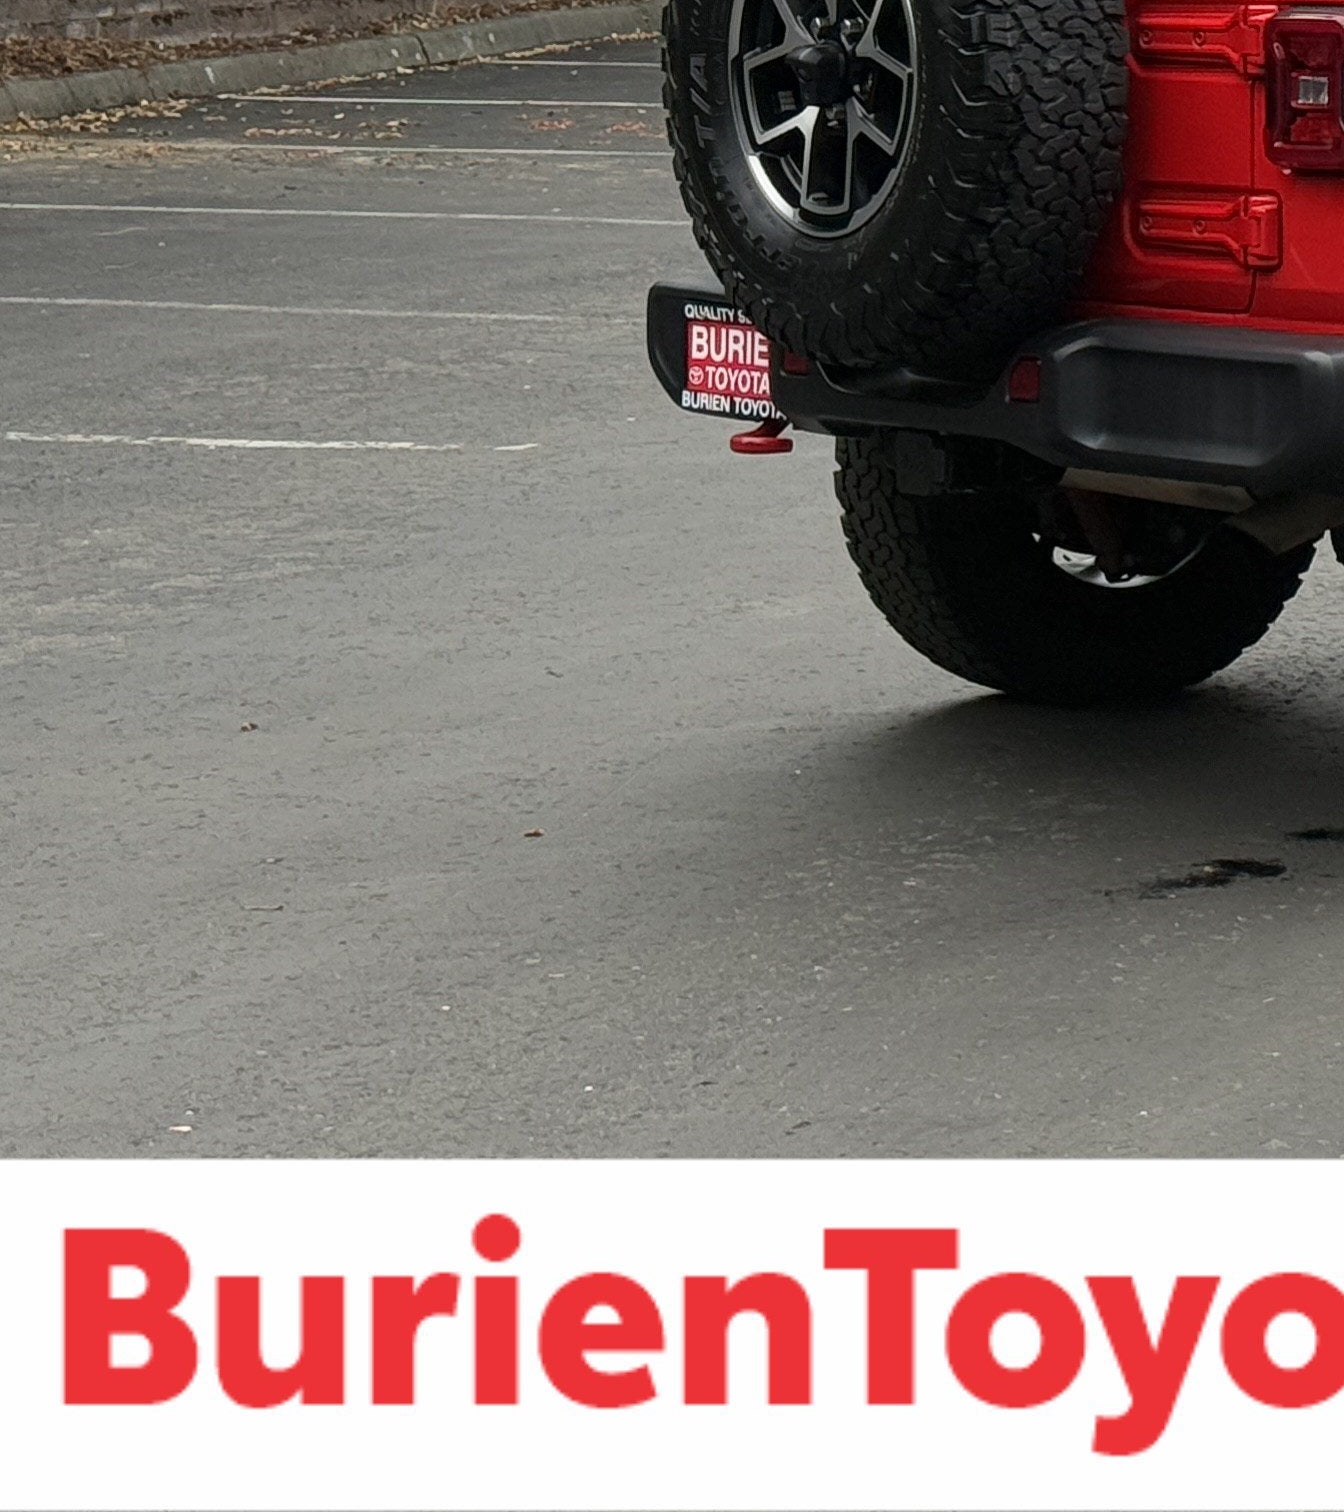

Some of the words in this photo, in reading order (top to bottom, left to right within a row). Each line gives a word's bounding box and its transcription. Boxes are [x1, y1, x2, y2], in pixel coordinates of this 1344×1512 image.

[684, 304, 734, 322] QUALITY
[692, 325, 769, 366] BURIE
[706, 366, 770, 394] TOYOTA
[682, 391, 730, 412] BURIEN
